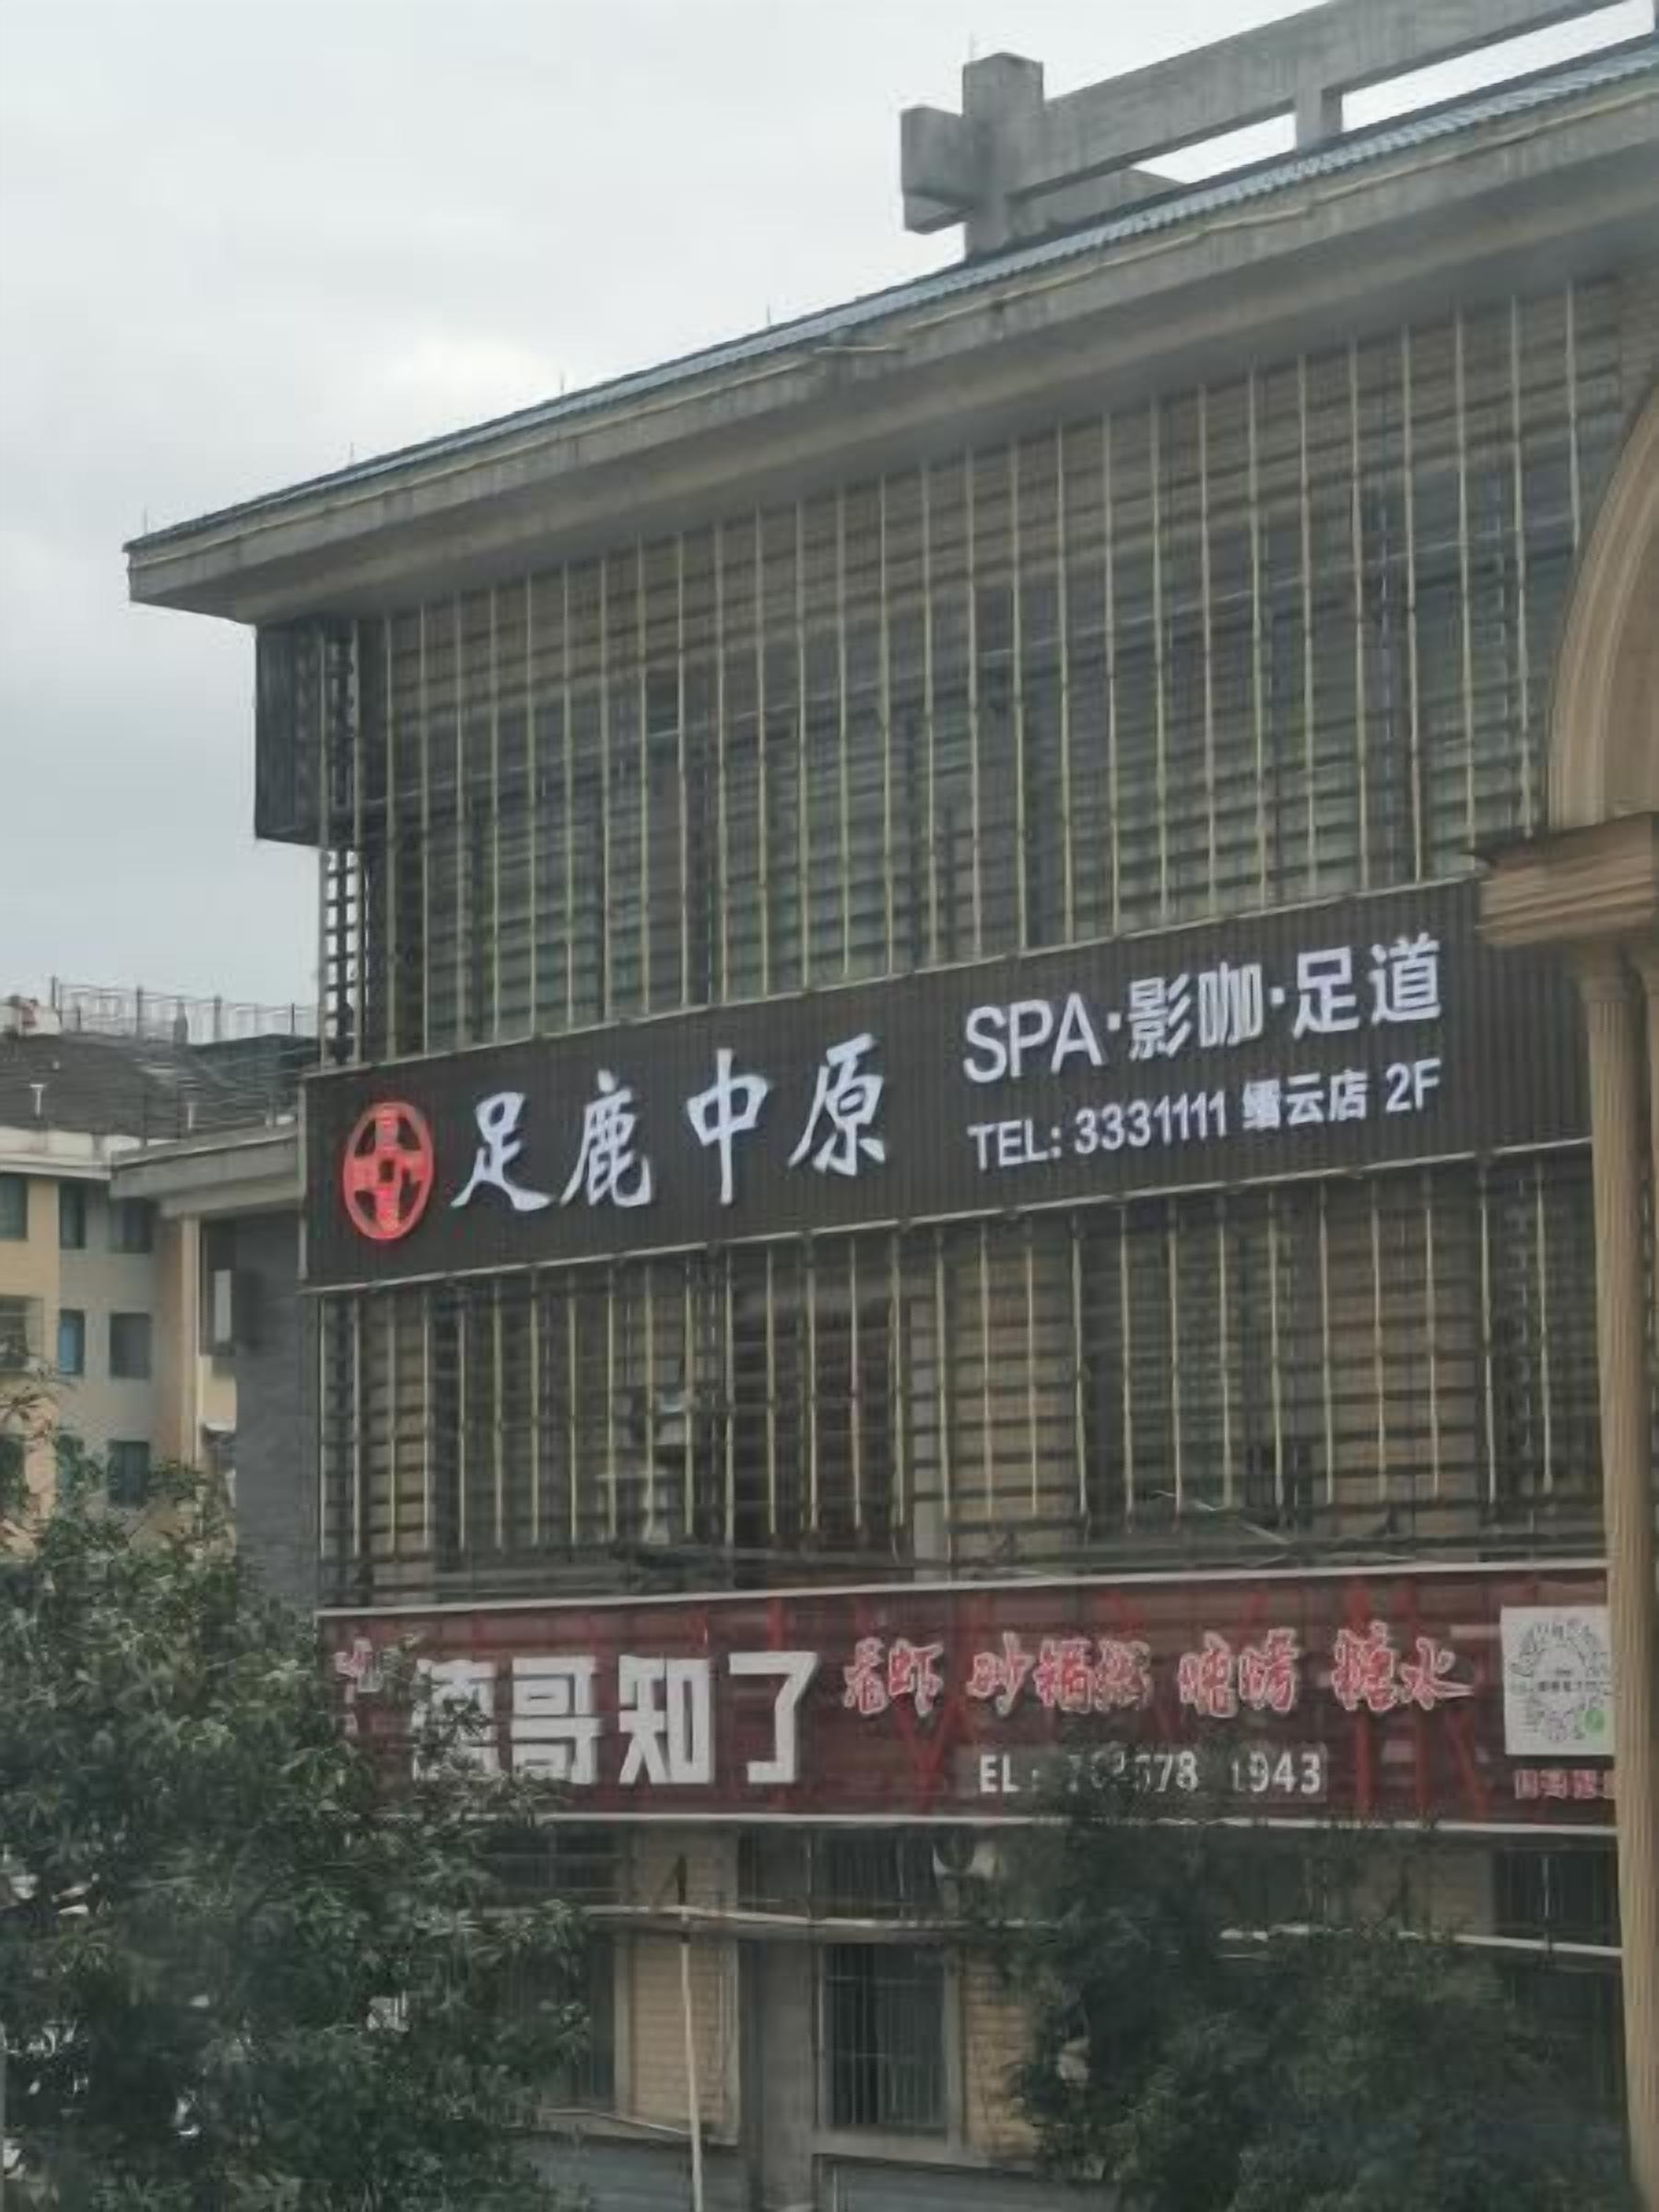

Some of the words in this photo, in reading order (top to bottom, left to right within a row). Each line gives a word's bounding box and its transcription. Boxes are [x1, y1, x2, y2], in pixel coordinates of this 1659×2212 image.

[450, 1032, 887, 1212] 足鹿中原
[1073, 1090, 1227, 1155] 3331111
[1385, 1058, 1442, 1113] 2F
